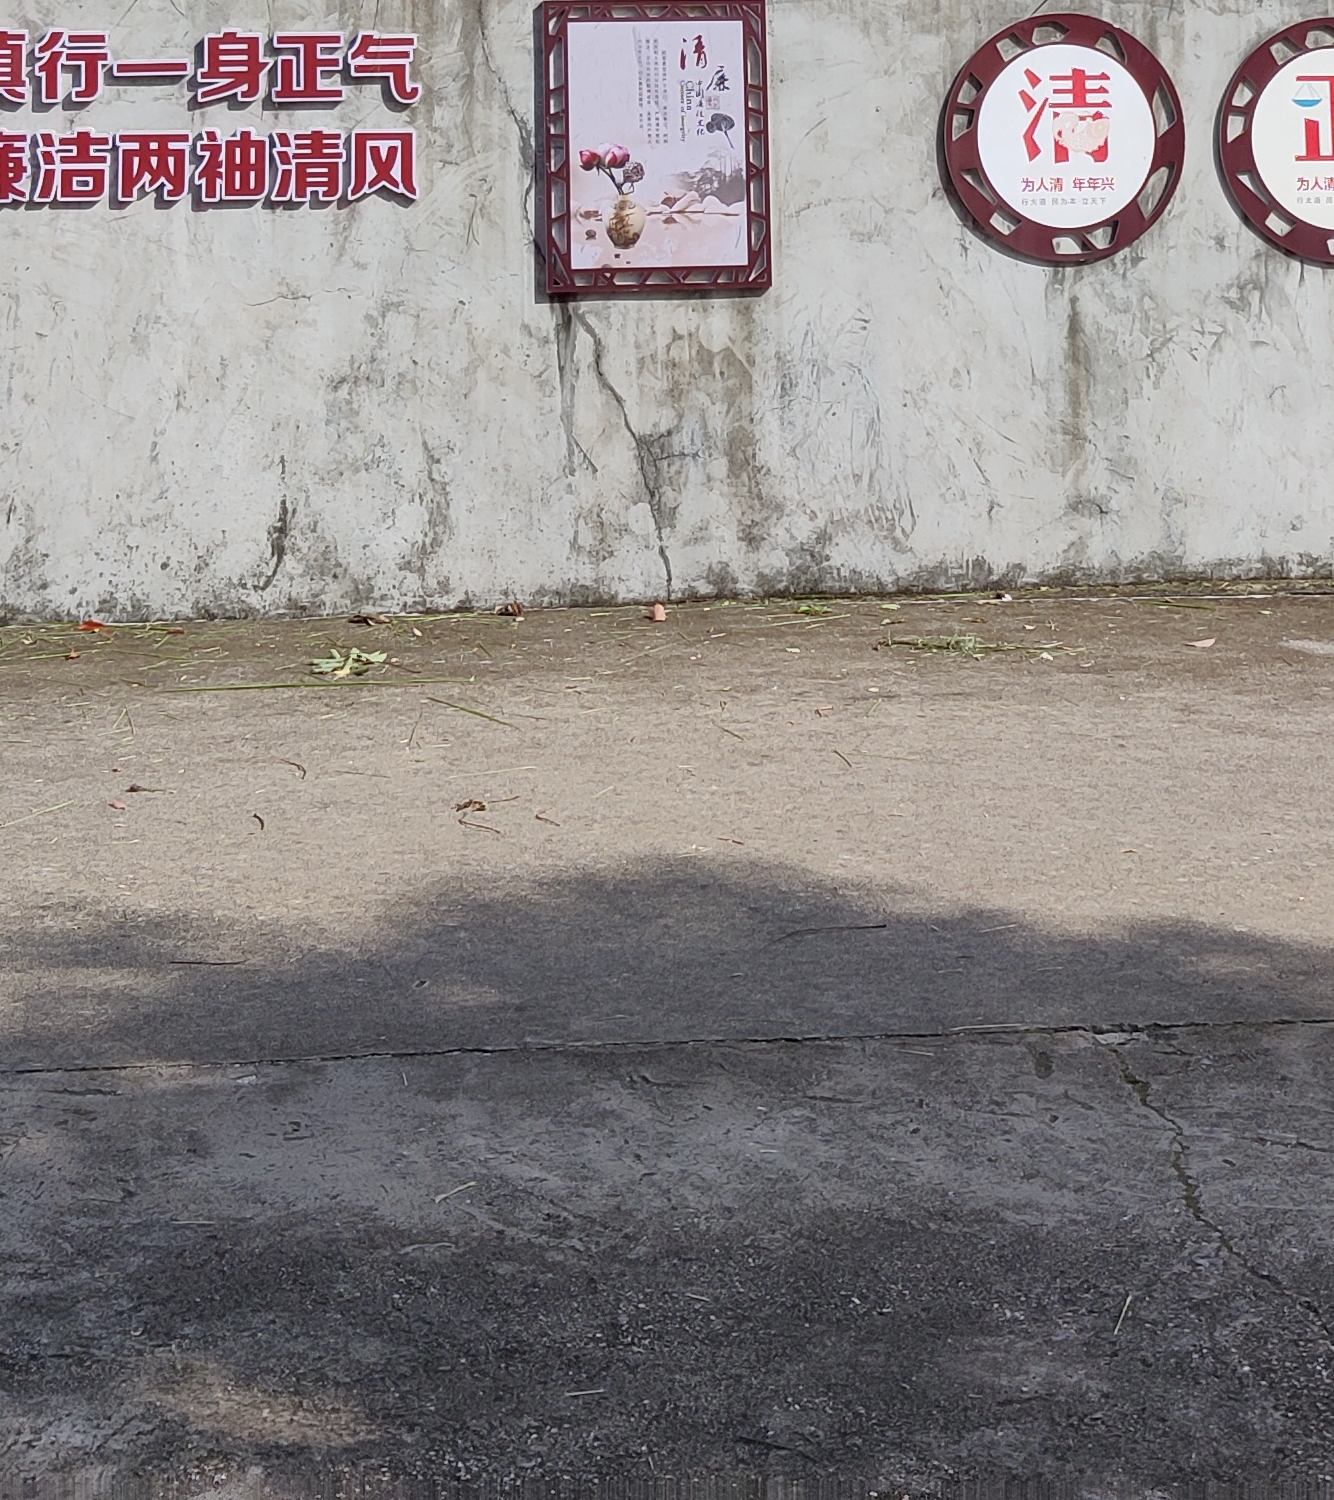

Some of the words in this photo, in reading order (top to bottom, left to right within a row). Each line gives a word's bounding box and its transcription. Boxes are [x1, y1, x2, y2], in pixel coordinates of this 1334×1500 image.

[685, 80, 694, 110] China
[1021, 177, 1063, 192] 为人清
[1072, 177, 1115, 191] 年年兴
